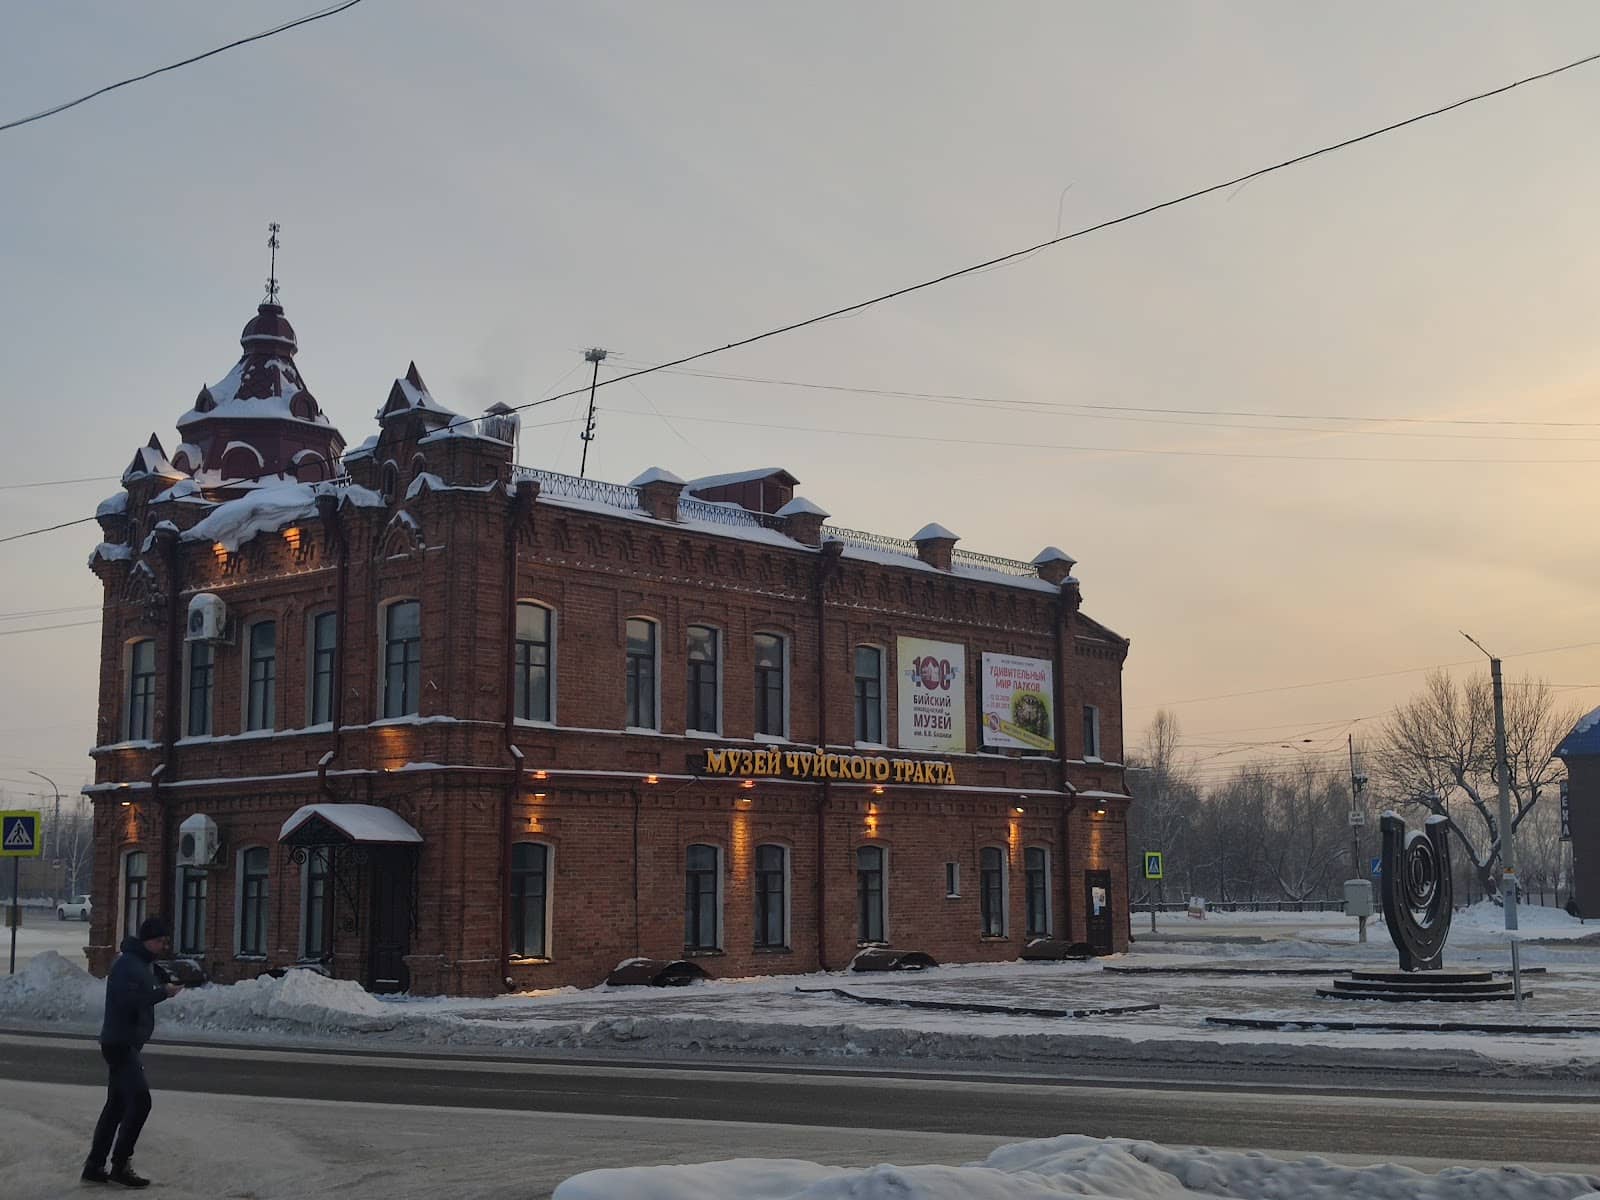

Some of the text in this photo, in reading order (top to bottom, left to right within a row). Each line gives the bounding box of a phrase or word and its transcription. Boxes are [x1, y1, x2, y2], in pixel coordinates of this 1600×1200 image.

[990, 666, 1046, 681] УДИВИТЕЛЬНЫЙ
[995, 680, 1041, 693] МИР ПАУКОВ
[913, 693, 951, 707] БИЙСКИЙ
[913, 712, 952, 730] МУЗЕЙ
[706, 748, 957, 785] МУЗЕЙ ЧУЙСКОГО ТРАКТА
